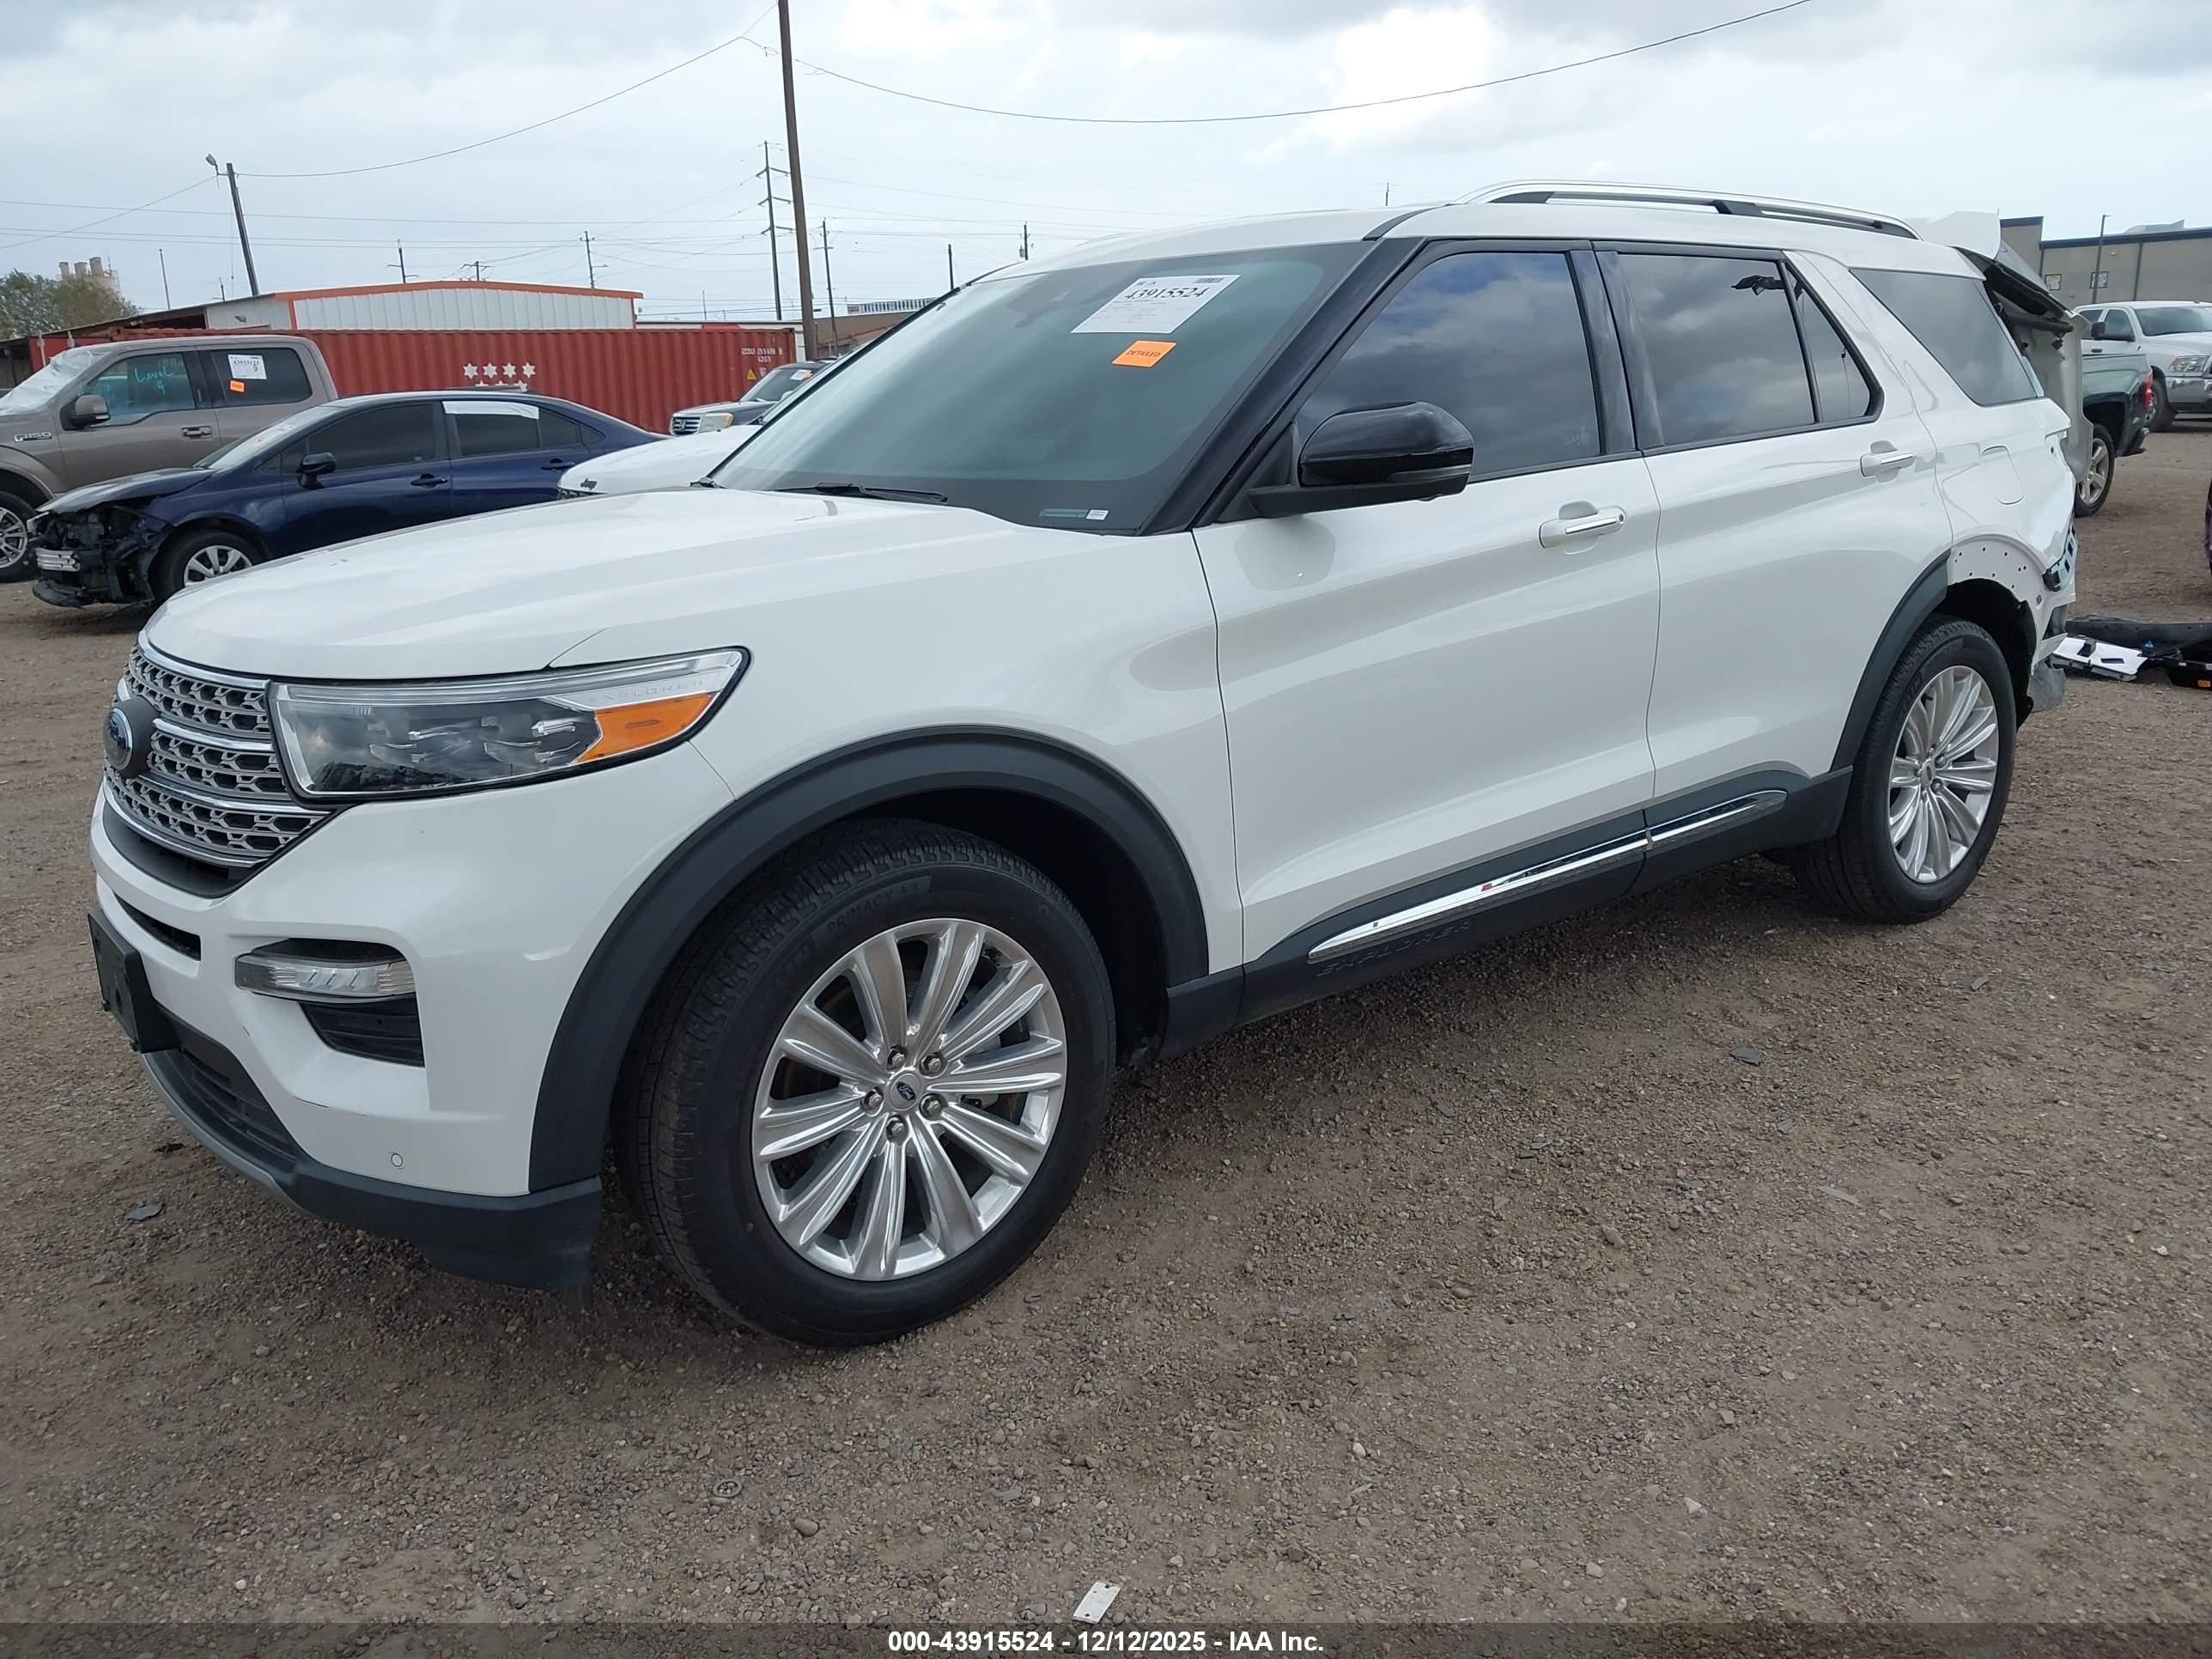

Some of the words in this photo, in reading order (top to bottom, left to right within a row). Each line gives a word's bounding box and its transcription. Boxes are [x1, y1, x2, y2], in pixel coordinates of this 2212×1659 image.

[1125, 287, 1210, 301] 43915524
[580, 477, 598, 490] Jeep
[827, 890, 894, 933] PRIMACY
